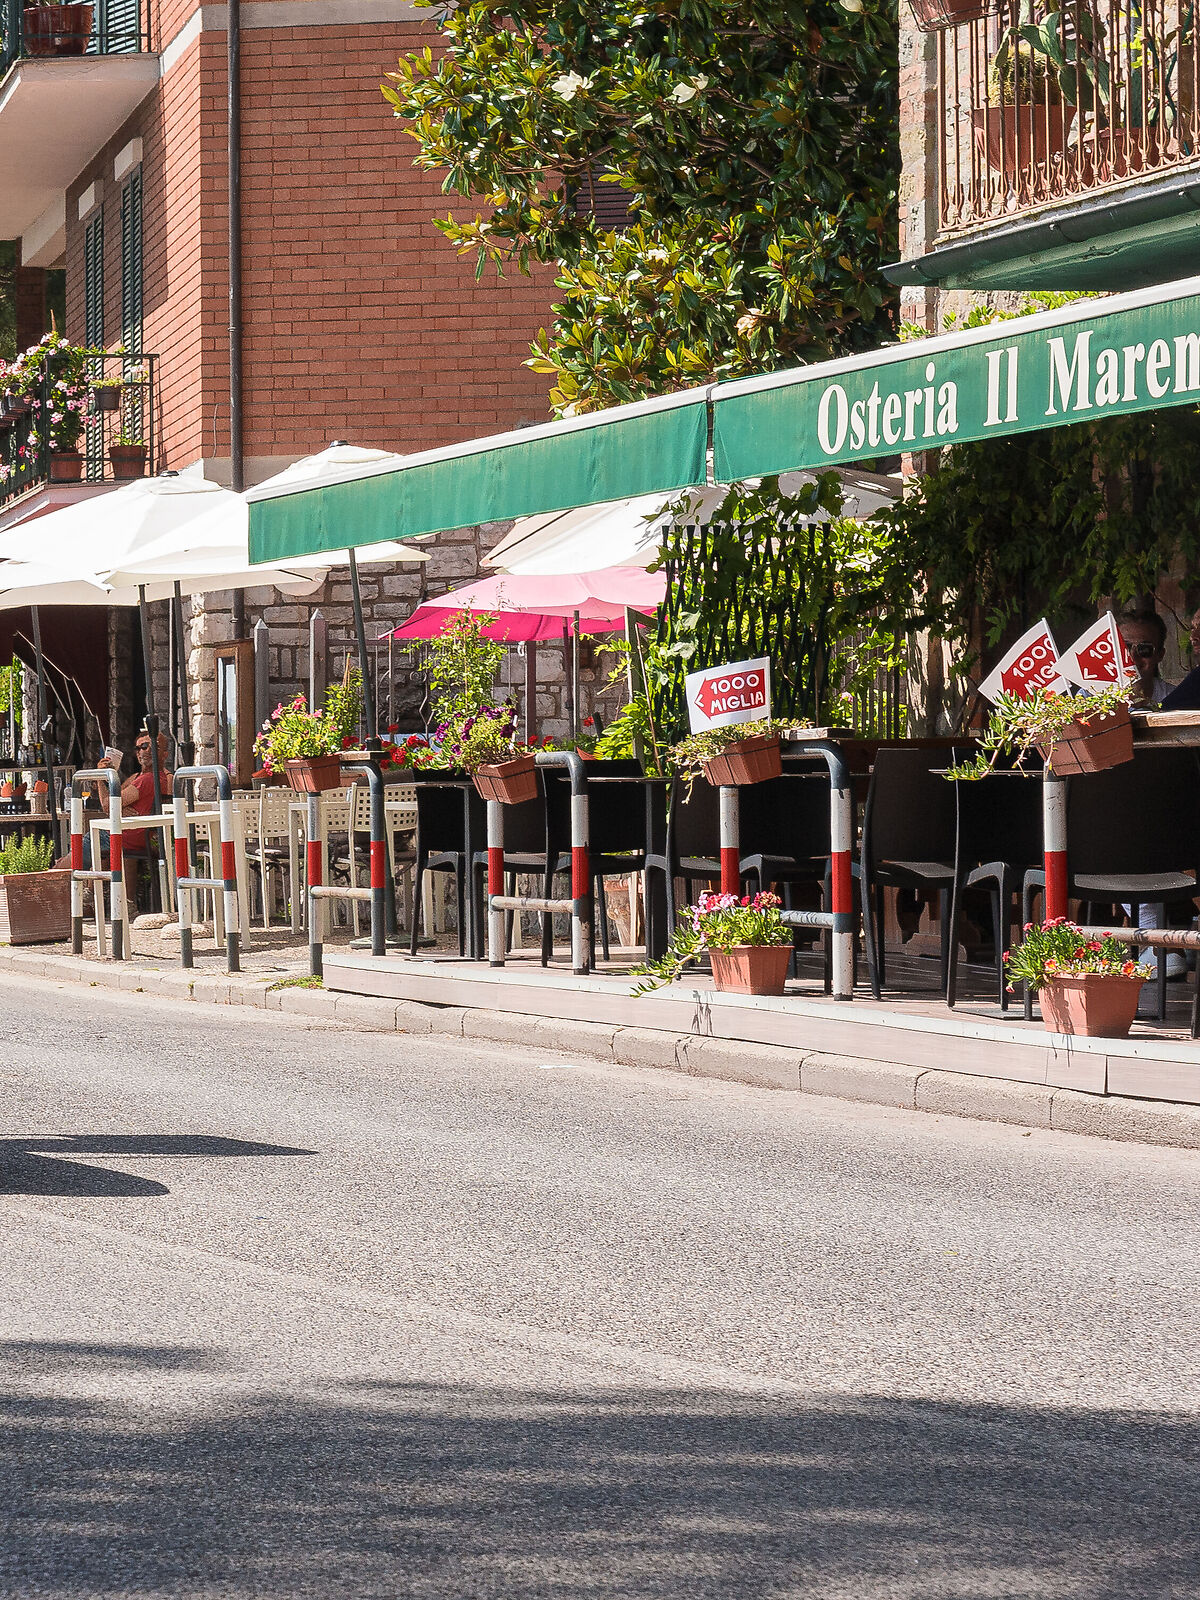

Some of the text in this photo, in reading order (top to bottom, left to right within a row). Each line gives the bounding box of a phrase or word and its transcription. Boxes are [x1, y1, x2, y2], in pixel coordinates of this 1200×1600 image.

[817, 361, 959, 455] Osteria
[983, 346, 1019, 427] Il
[710, 673, 760, 695] 1000
[710, 691, 764, 714] MIGLIA
